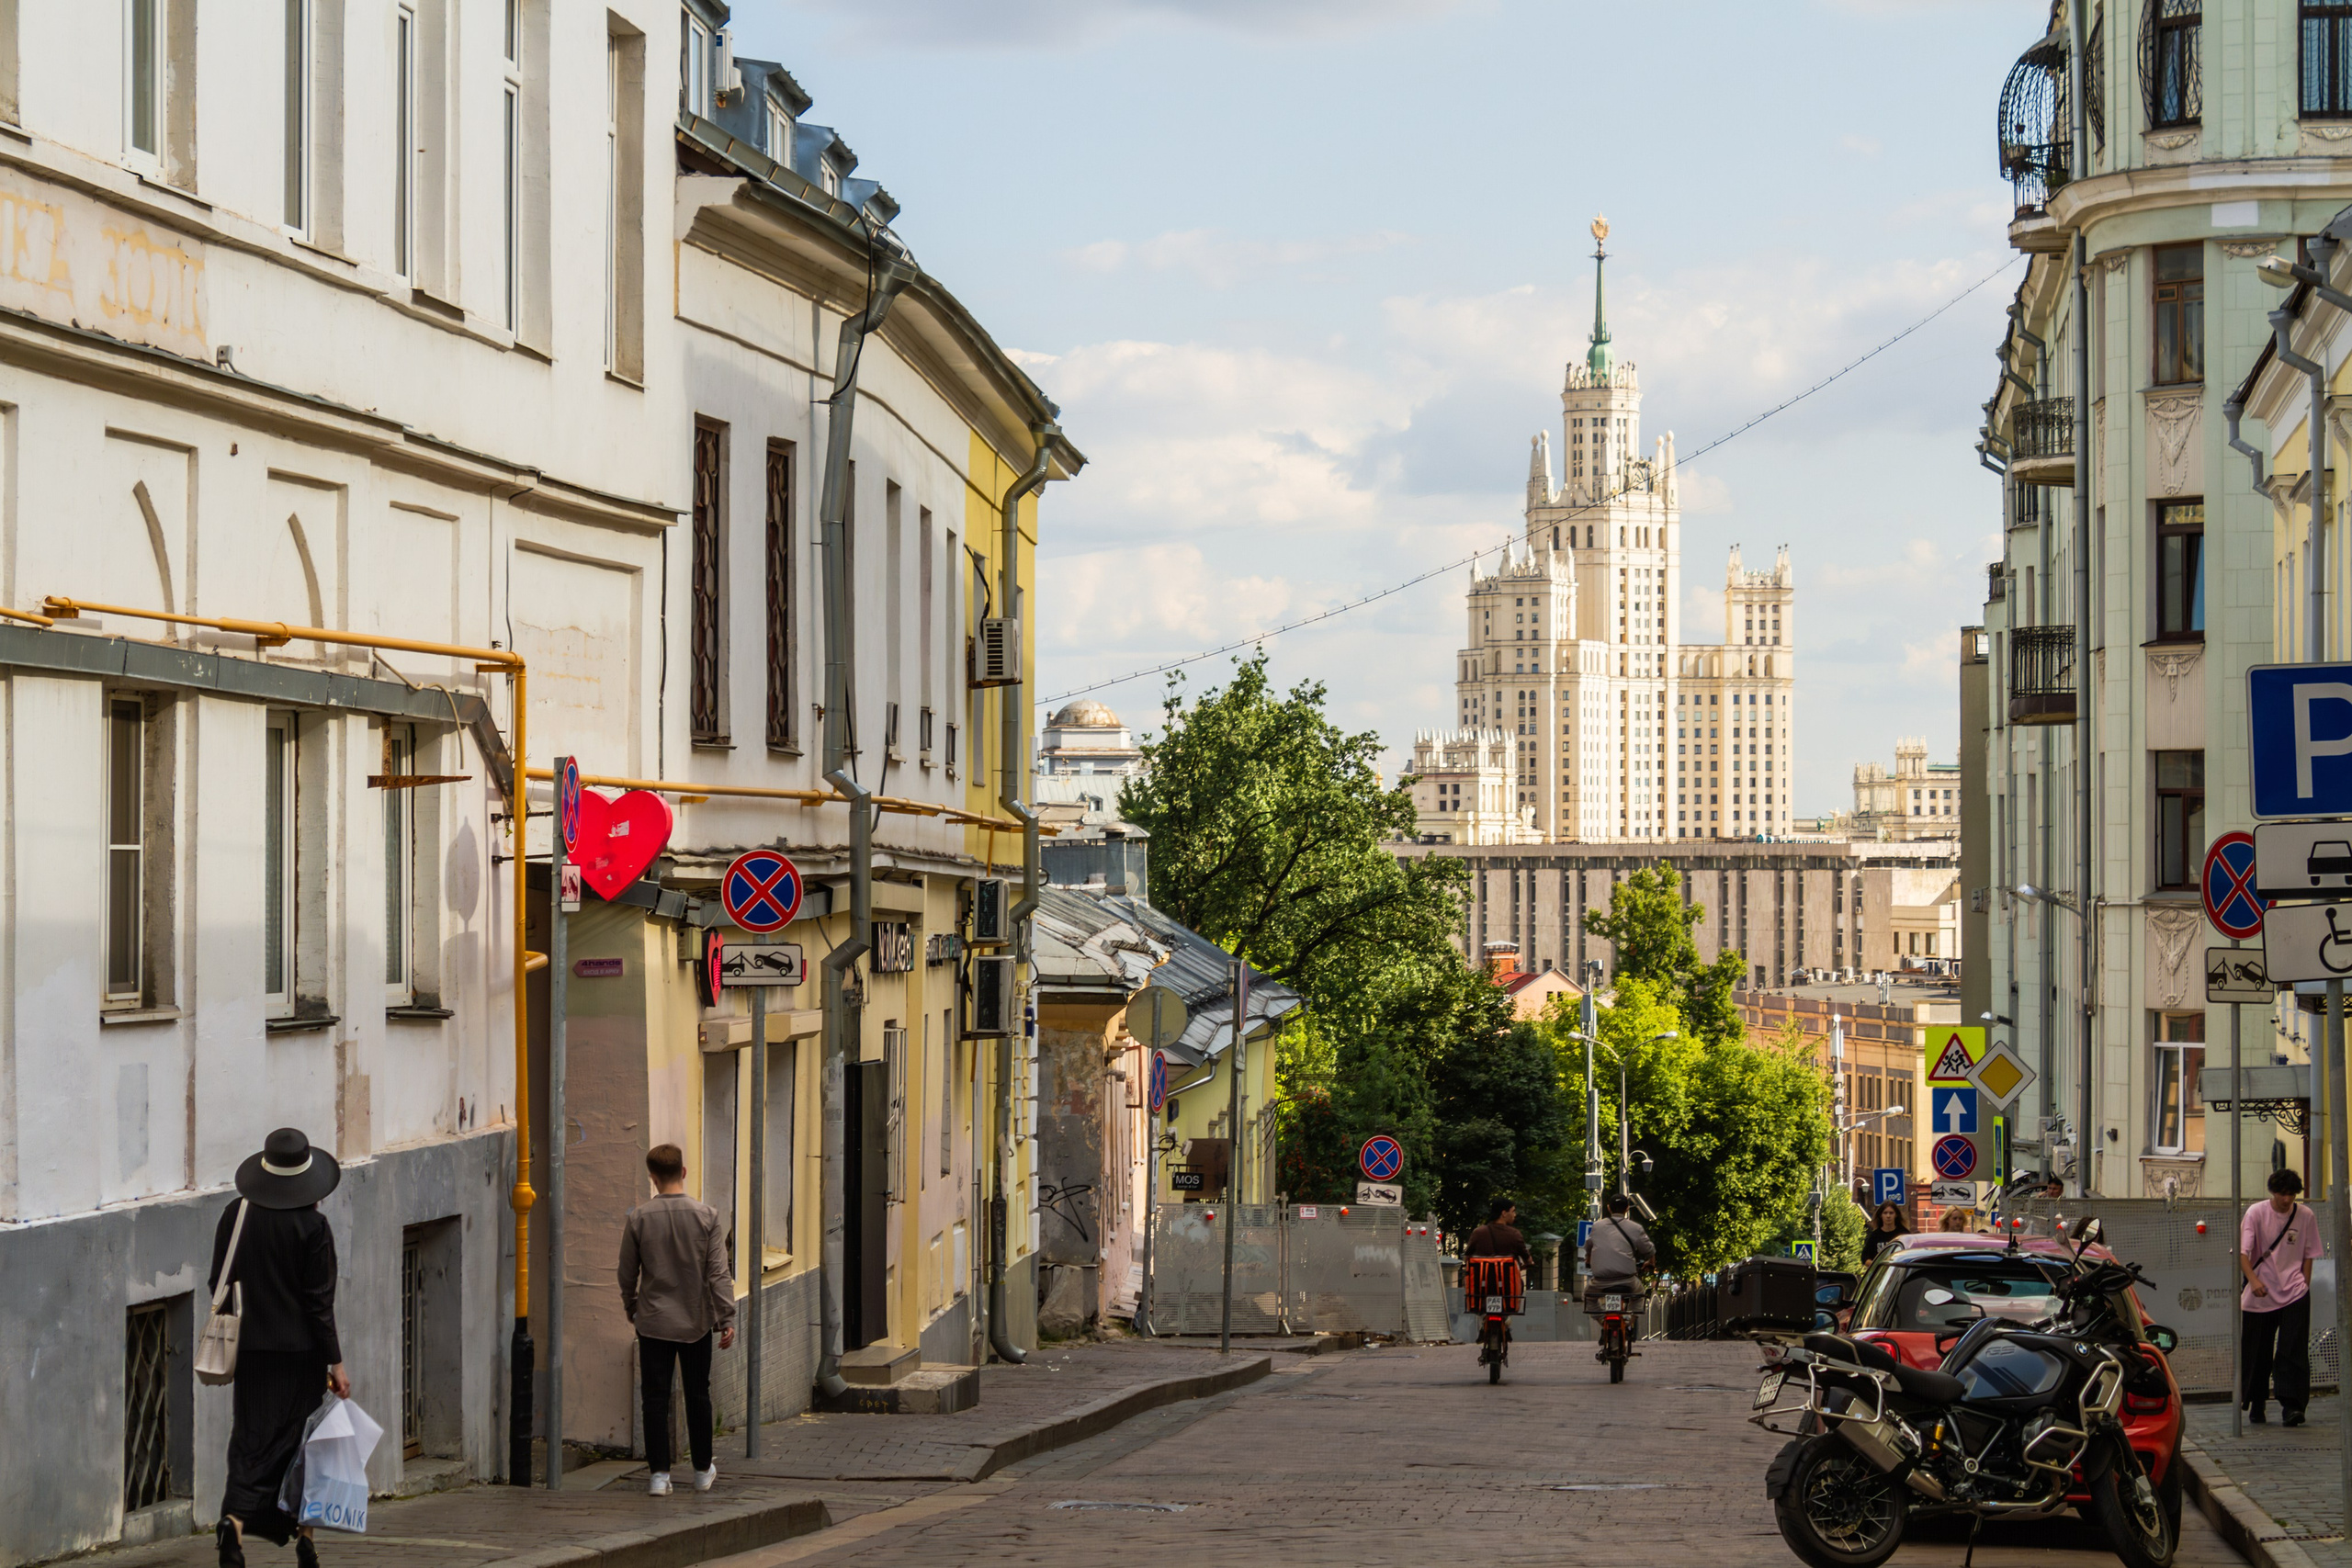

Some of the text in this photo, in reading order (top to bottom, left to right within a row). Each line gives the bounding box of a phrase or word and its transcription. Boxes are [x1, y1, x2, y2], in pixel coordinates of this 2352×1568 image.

[2293, 682, 2352, 798] P
[1176, 1176, 1199, 1184] MOS
[1883, 1173, 1898, 1201] P
[1985, 1346, 2016, 1357] GS
